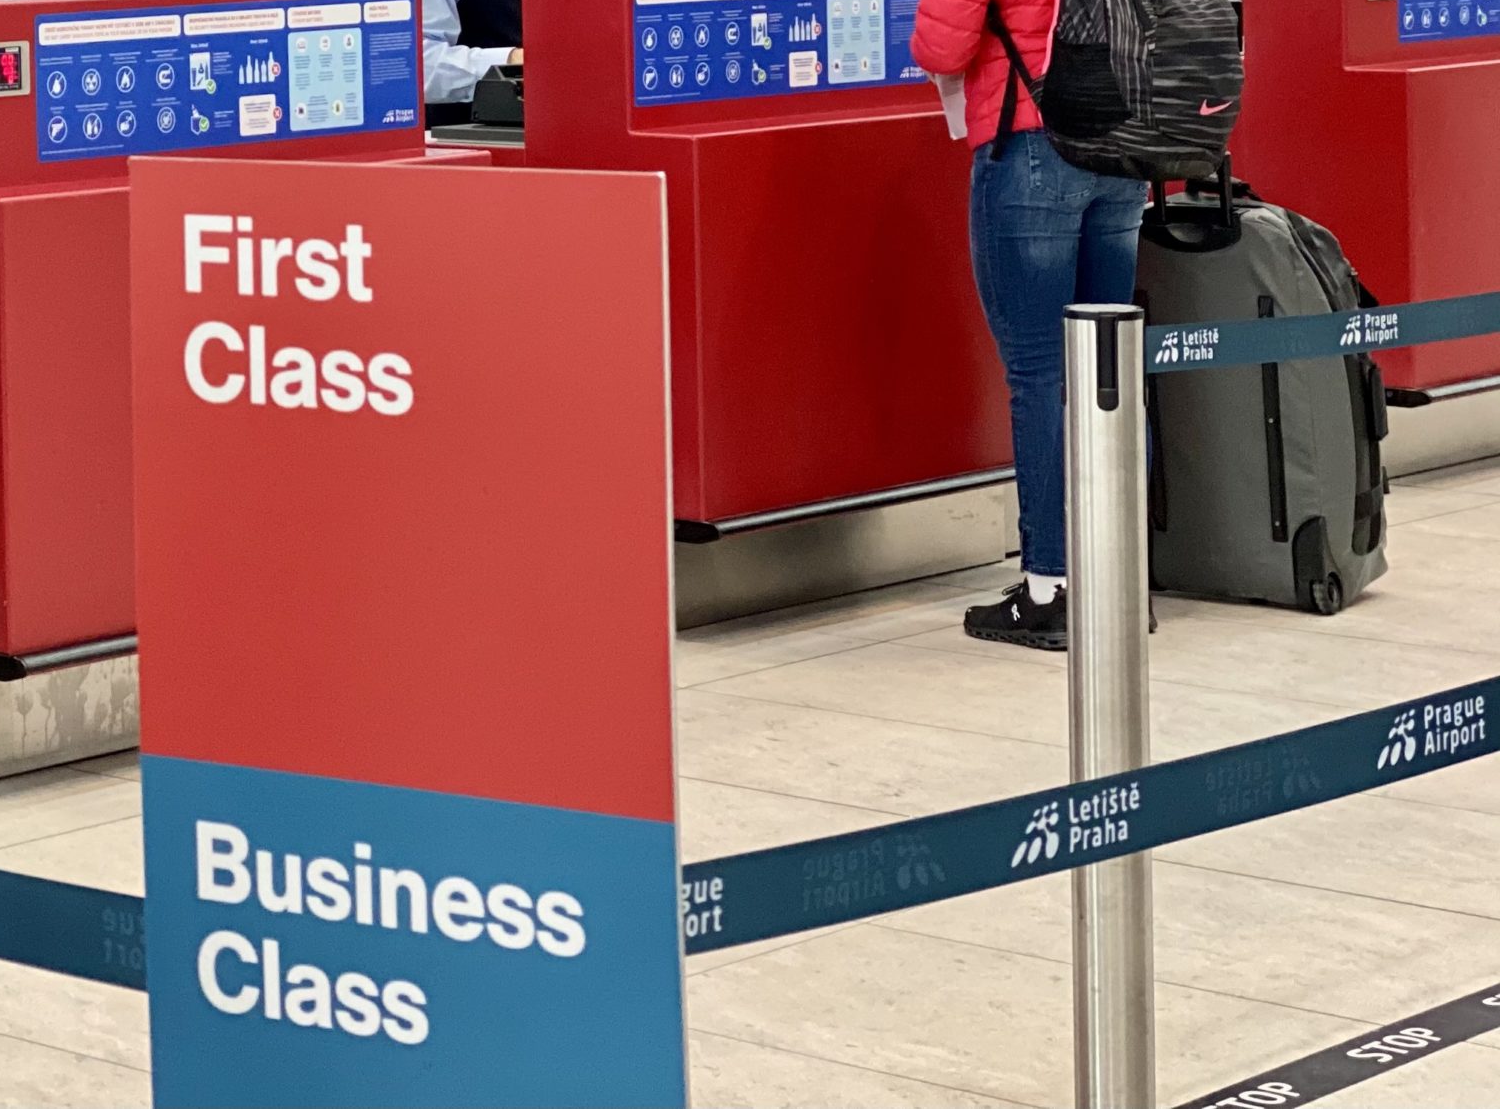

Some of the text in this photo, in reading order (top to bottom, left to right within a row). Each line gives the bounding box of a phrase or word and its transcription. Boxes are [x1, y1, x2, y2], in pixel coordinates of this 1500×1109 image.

[182, 213, 374, 303] First
[1182, 326, 1219, 347] Letiště
[1364, 311, 1399, 332] Prague
[1364, 325, 1399, 346] Airport
[181, 321, 415, 417] Class
[1183, 343, 1214, 362] Praha
[1423, 695, 1485, 730] Prague
[1423, 718, 1486, 756] Airport
[1068, 781, 1140, 824] Letiště
[1069, 817, 1129, 854] Praha
[195, 819, 588, 959] Business
[196, 930, 431, 1046] Class
[1346, 1027, 1442, 1063] STOP
